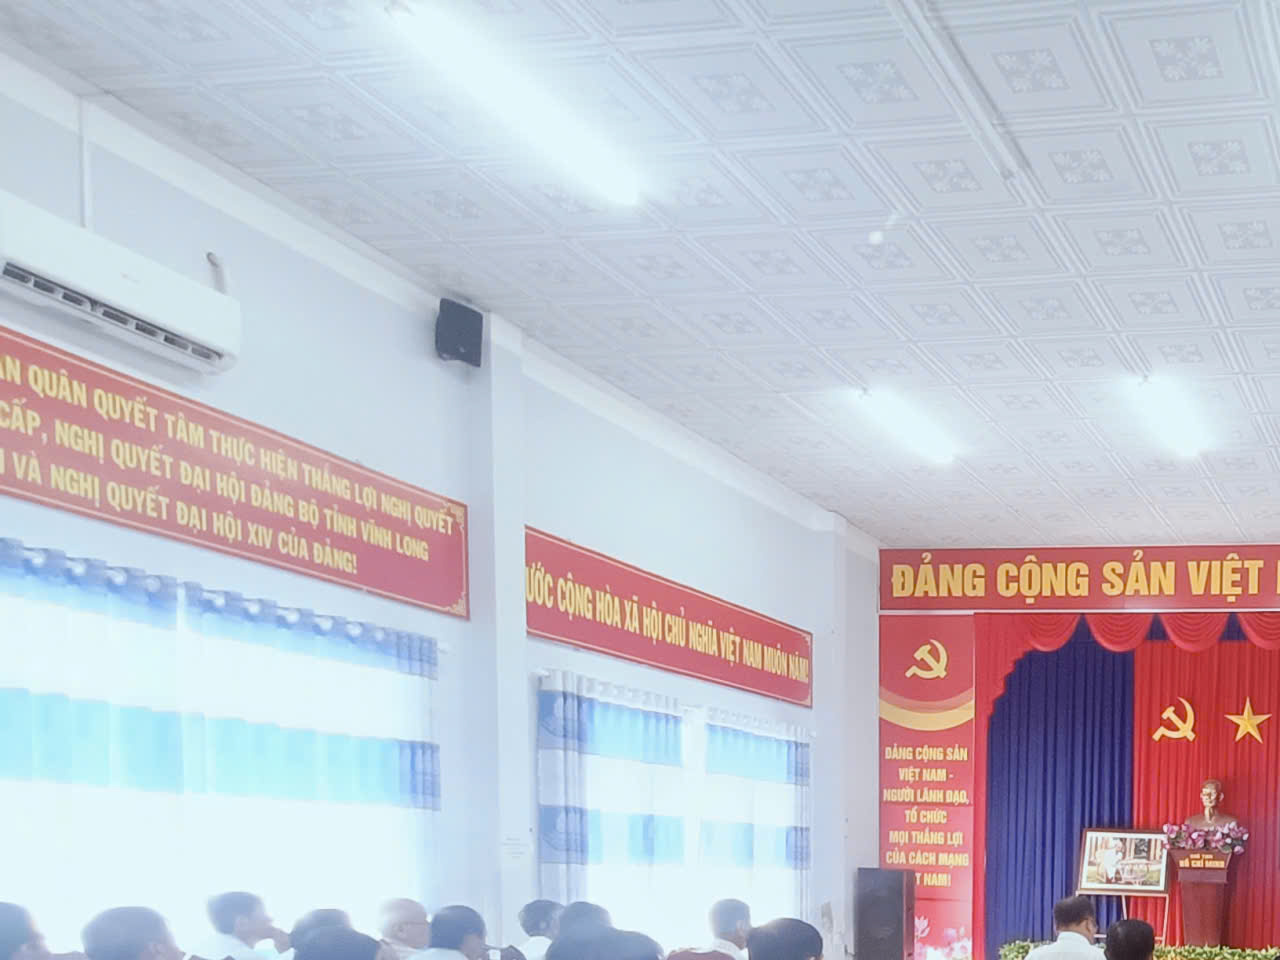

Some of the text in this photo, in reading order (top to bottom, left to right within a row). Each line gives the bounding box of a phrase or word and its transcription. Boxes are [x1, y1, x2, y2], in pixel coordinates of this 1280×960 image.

[28, 364, 88, 409] QUÂN
[93, 387, 158, 433] QUYẾT
[163, 411, 205, 448] TÂM
[208, 429, 255, 466] THỰC
[260, 447, 298, 481] HIỆN
[354, 483, 378, 512] LỢI
[381, 492, 412, 527] NGHỊ
[414, 502, 454, 536] QUYẾT
[55, 418, 105, 465] NGHỊ
[110, 438, 174, 480] QUYẾT
[179, 460, 211, 494] ĐẠI
[215, 471, 246, 505] HỘI
[250, 480, 294, 518] ĐẢNG
[298, 498, 320, 530] BỘ
[323, 503, 357, 539] TỈNH
[395, 531, 429, 562] LONG
[12, 449, 42, 486] VÀ
[49, 463, 100, 508] NGHỊ
[106, 484, 170, 520] QUYẾT
[175, 500, 208, 535] ĐẠI
[212, 510, 242, 544] HỘI
[247, 520, 273, 549] XIV
[278, 526, 309, 561] CỦA
[312, 537, 358, 575] ĐẢNG!
[891, 552, 985, 597] ĐẢNG
[997, 555, 1089, 604] CỘNG
[1101, 550, 1176, 596] SẢN
[1187, 553, 1264, 602] VIỆT
[557, 571, 593, 621] CỘNG
[595, 584, 622, 629] HÒA
[624, 595, 640, 634] XÃ
[642, 600, 662, 645] HỘI
[664, 605, 687, 648] CHỦ
[688, 619, 719, 657] NGHĨA
[719, 626, 741, 667] VIỆT
[742, 638, 763, 670] NAM
[763, 642, 788, 677] MUÔN
[884, 743, 968, 763] ĐẢNG CỘNG SẢN
[898, 765, 920, 784] VIỆT
[922, 767, 947, 782] NAM
[883, 785, 915, 802] NGƯỜI
[916, 786, 944, 803] LÃNH
[920, 807, 948, 824] CHỨC
[888, 826, 964, 848] MỌI THẮNG LỢI
[886, 847, 969, 869] CỦA CÁCH MẠNG
